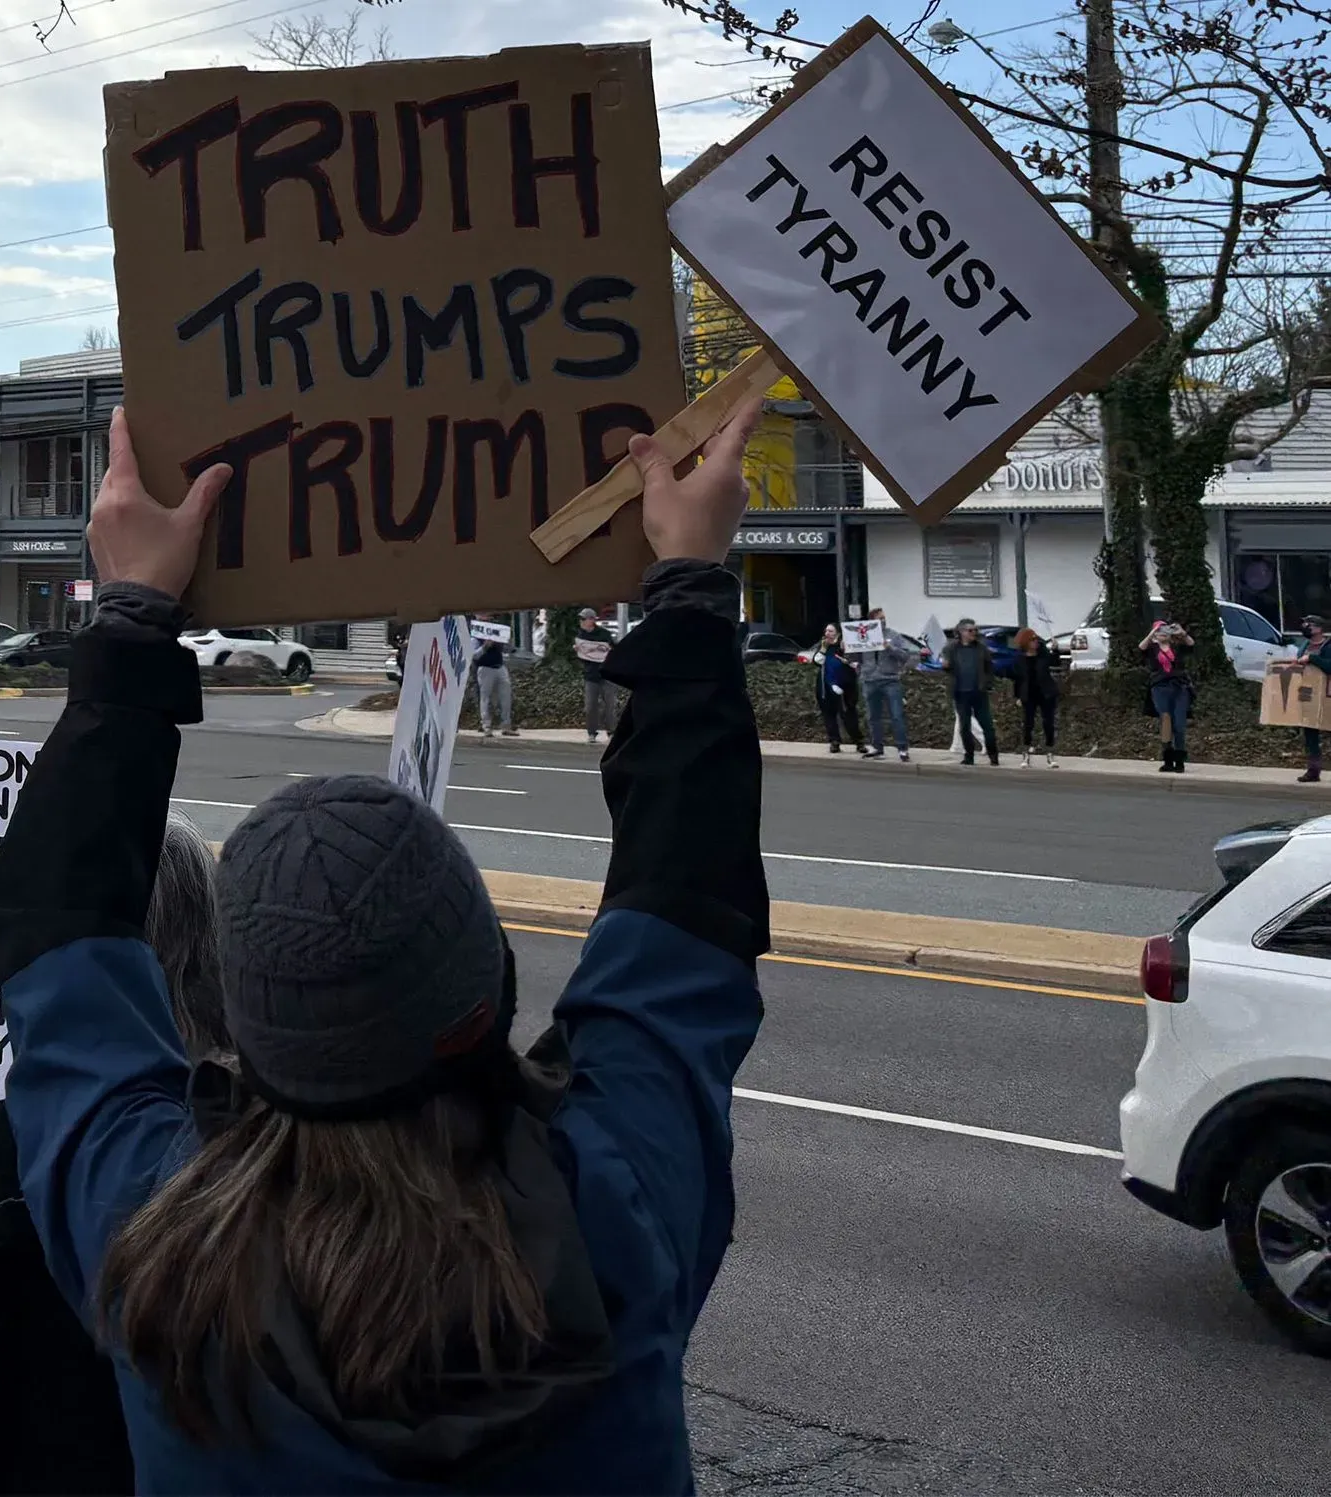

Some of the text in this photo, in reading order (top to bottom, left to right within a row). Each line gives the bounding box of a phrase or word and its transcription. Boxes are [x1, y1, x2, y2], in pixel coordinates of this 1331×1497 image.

[132, 80, 601, 253] TRUTH
[828, 134, 1031, 337] RESIST
[175, 268, 641, 398] TRUMPS
[745, 154, 999, 421] TYRANNY
[31, 541, 51, 551] HOUSE
[180, 402, 655, 570] TRUMP
[745, 532, 782, 544] CIGARS
[787, 533, 794, 544] &
[797, 532, 823, 544] CIGS
